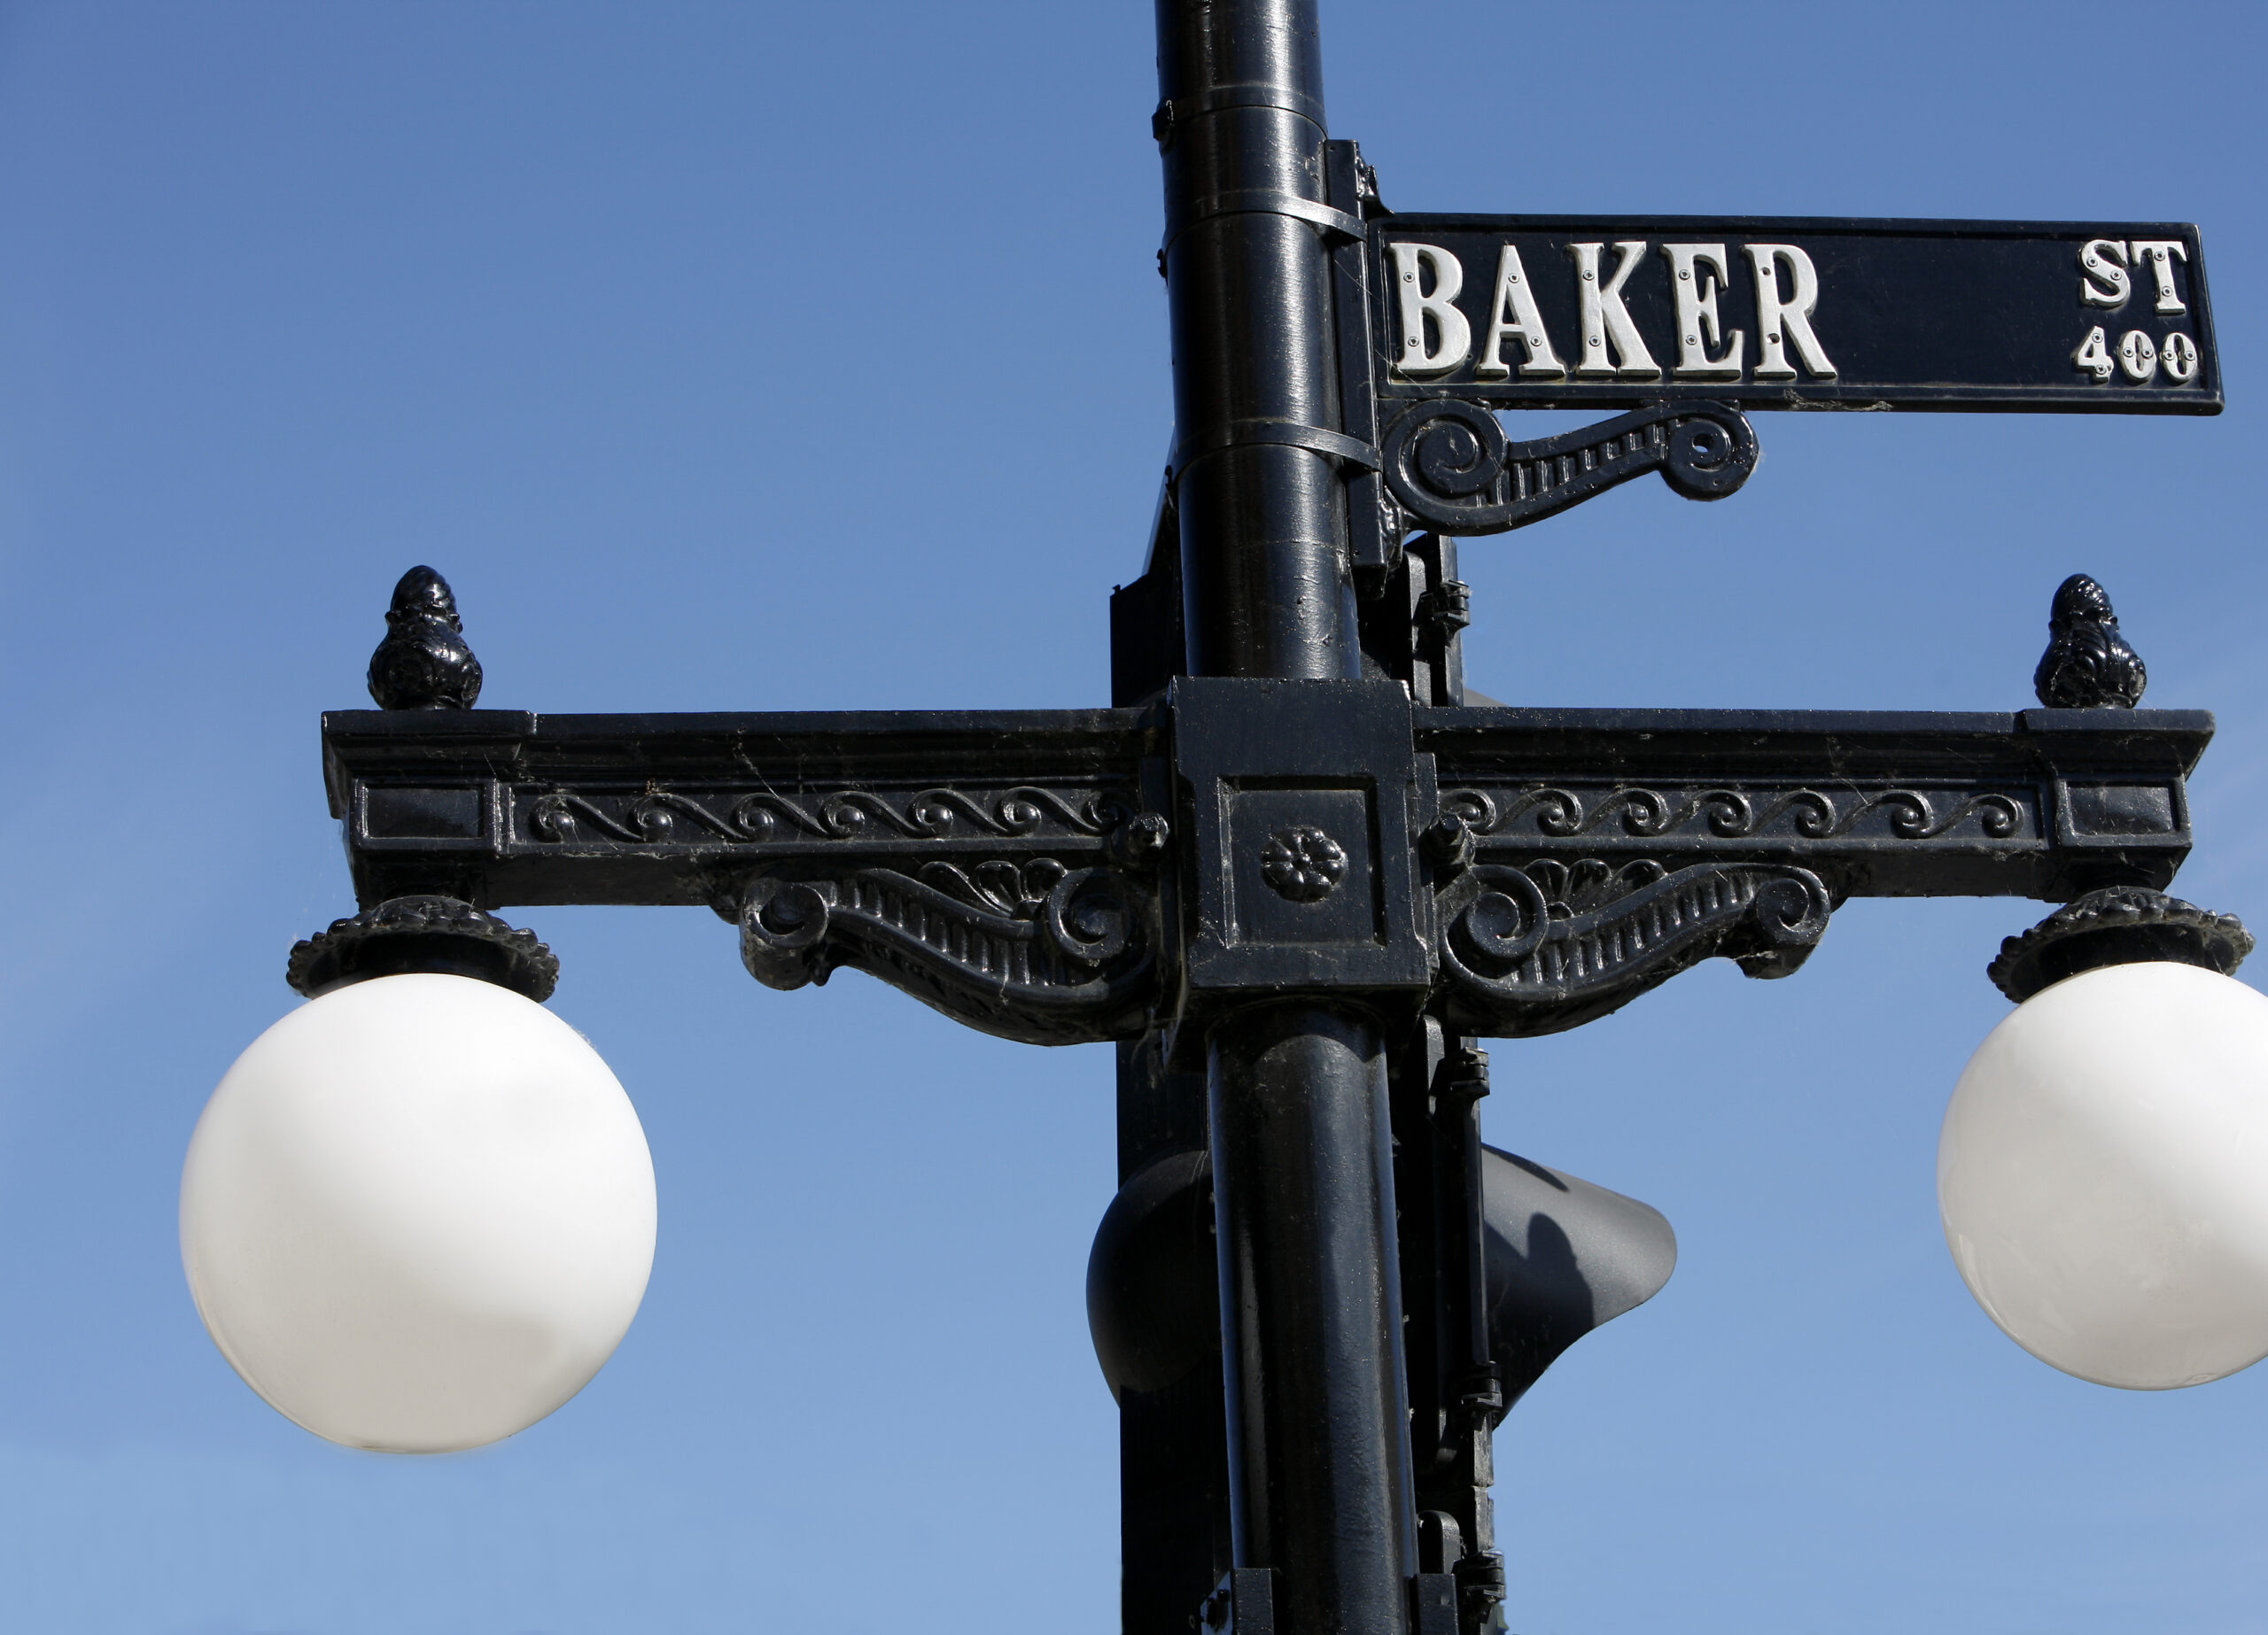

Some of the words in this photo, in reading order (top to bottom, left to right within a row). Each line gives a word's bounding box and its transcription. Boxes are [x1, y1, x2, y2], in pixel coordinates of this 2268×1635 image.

[1388, 241, 1838, 379] BAKER
[2079, 239, 2188, 314] ST
[2074, 325, 2200, 384] 400
